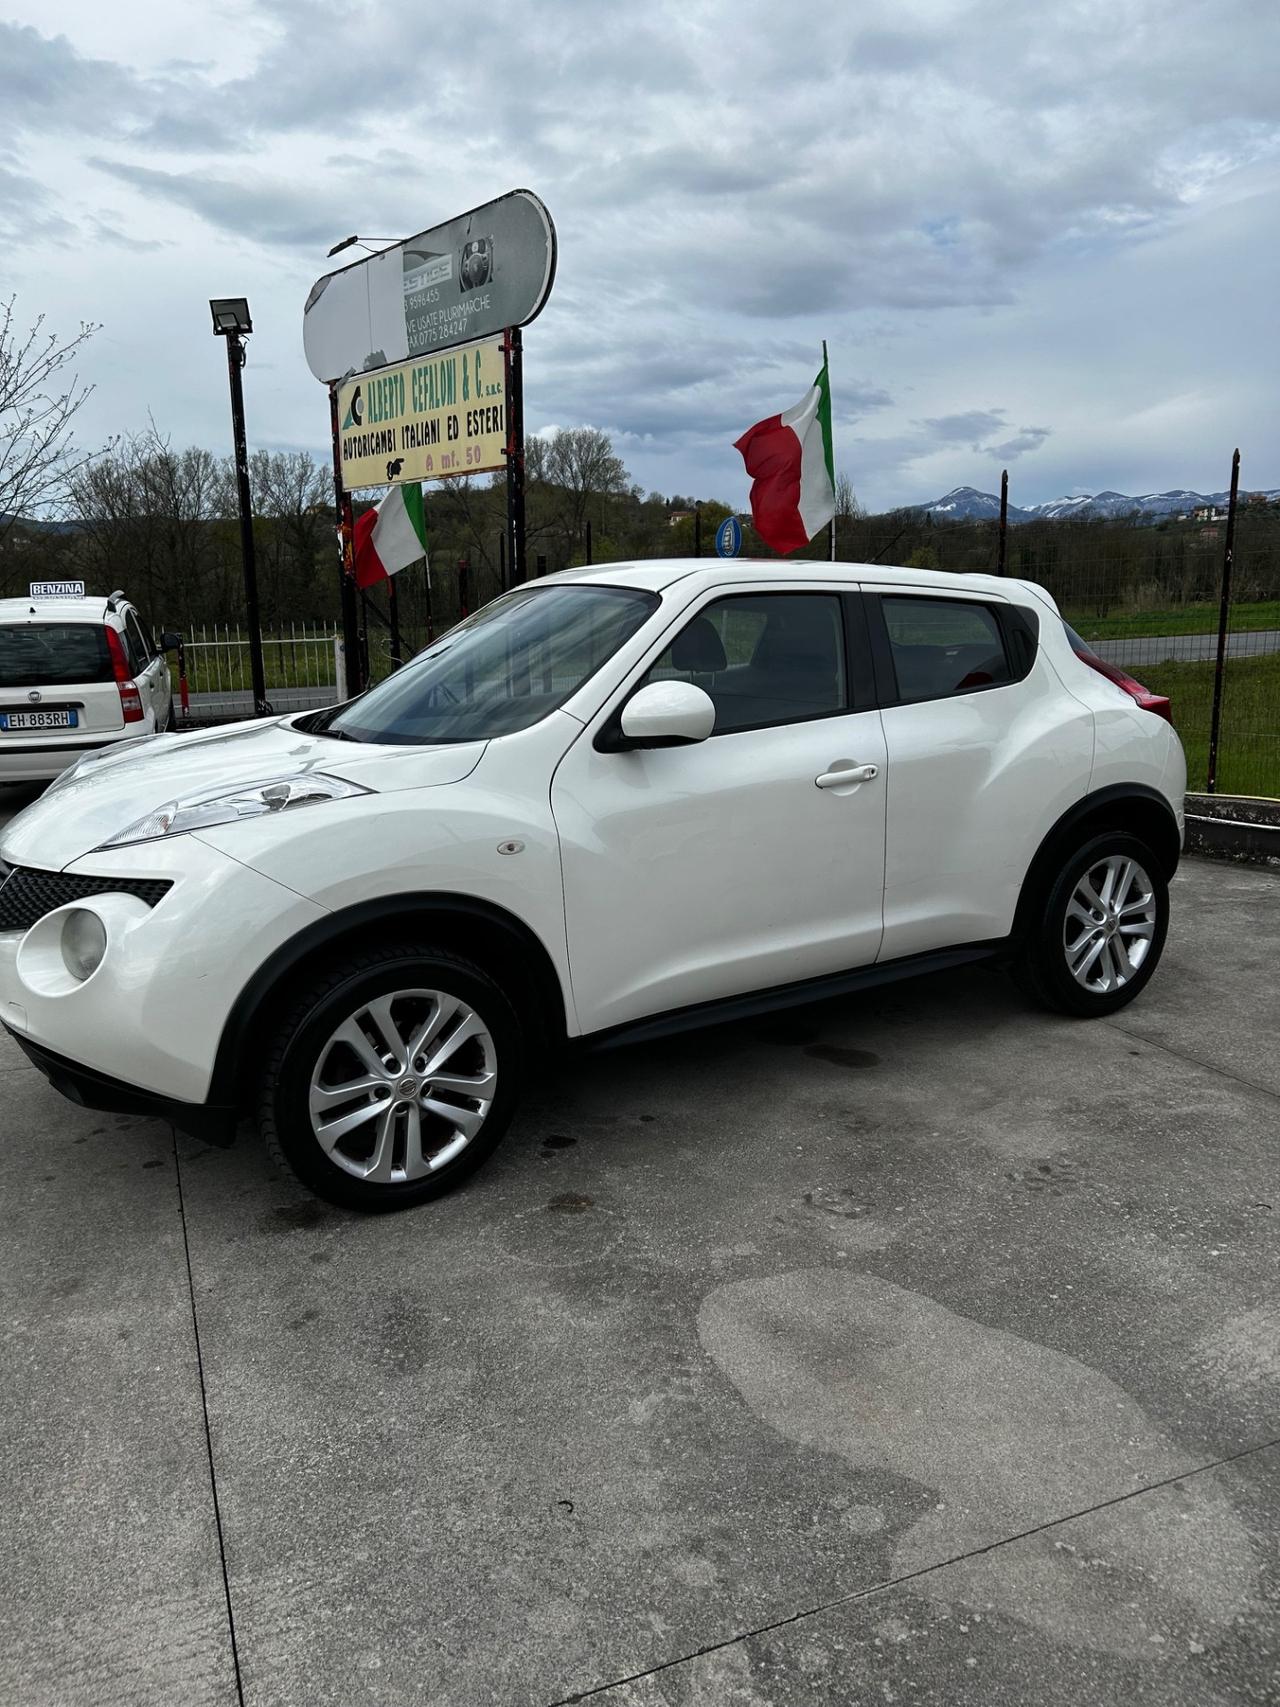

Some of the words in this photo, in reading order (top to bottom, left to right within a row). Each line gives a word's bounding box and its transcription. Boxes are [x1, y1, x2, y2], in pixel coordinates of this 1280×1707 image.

[409, 288, 440, 311] 9596455
[416, 311, 438, 330] USATE
[439, 294, 491, 323] PLURIMARCHE
[419, 328, 438, 346] 0775
[438, 318, 468, 340] 284247
[367, 372, 405, 424] ALBERTO
[412, 358, 457, 414] CEFALONI
[462, 353, 470, 402] &
[343, 428, 396, 461] AUTORICAMBI
[401, 418, 441, 450] ITALIANI
[447, 414, 459, 441] ED
[467, 404, 504, 438] ESTERI
[425, 454, 433, 471] A
[441, 450, 460, 468] mt.
[466, 445, 481, 465] 50
[32, 582, 83, 595] BENZINA
[9, 714, 26, 727] EH
[29, 711, 69, 726] 883RH
